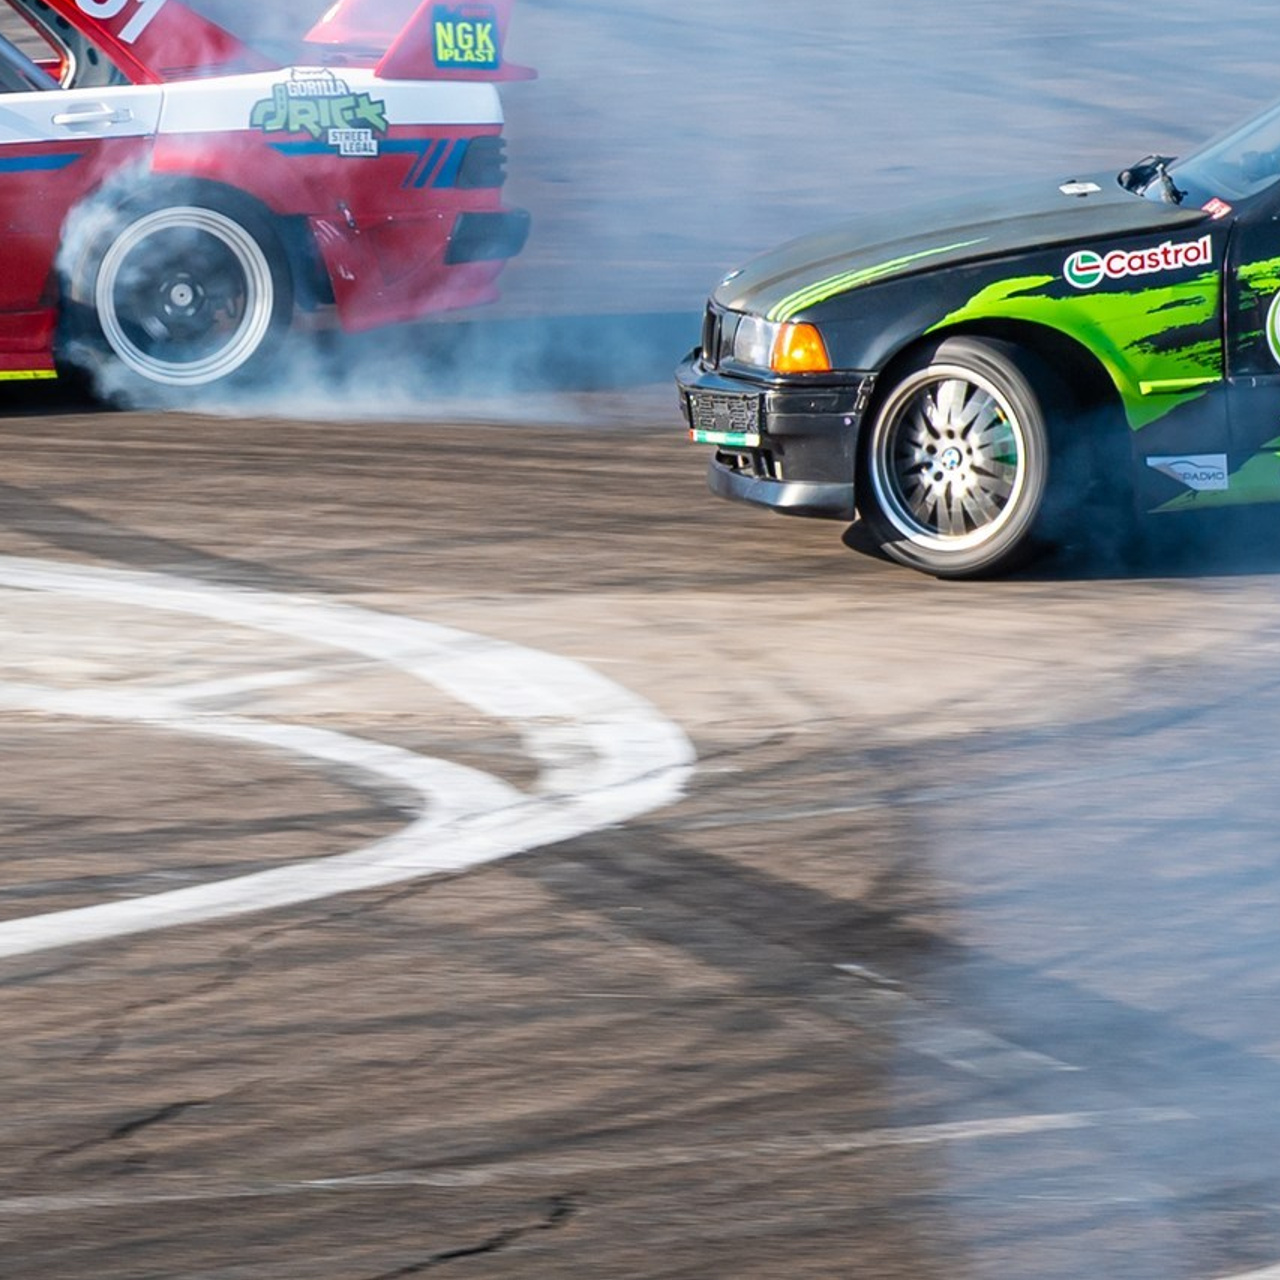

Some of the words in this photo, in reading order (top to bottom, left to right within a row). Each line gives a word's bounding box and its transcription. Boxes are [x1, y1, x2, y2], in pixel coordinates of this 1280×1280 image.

[435, 22, 495, 52] NGK
[442, 49, 495, 62] PLAST
[287, 81, 348, 95] GORILLA
[331, 131, 370, 142] STREET
[343, 142, 375, 153] LEGAL
[1106, 240, 1208, 275] Castrol
